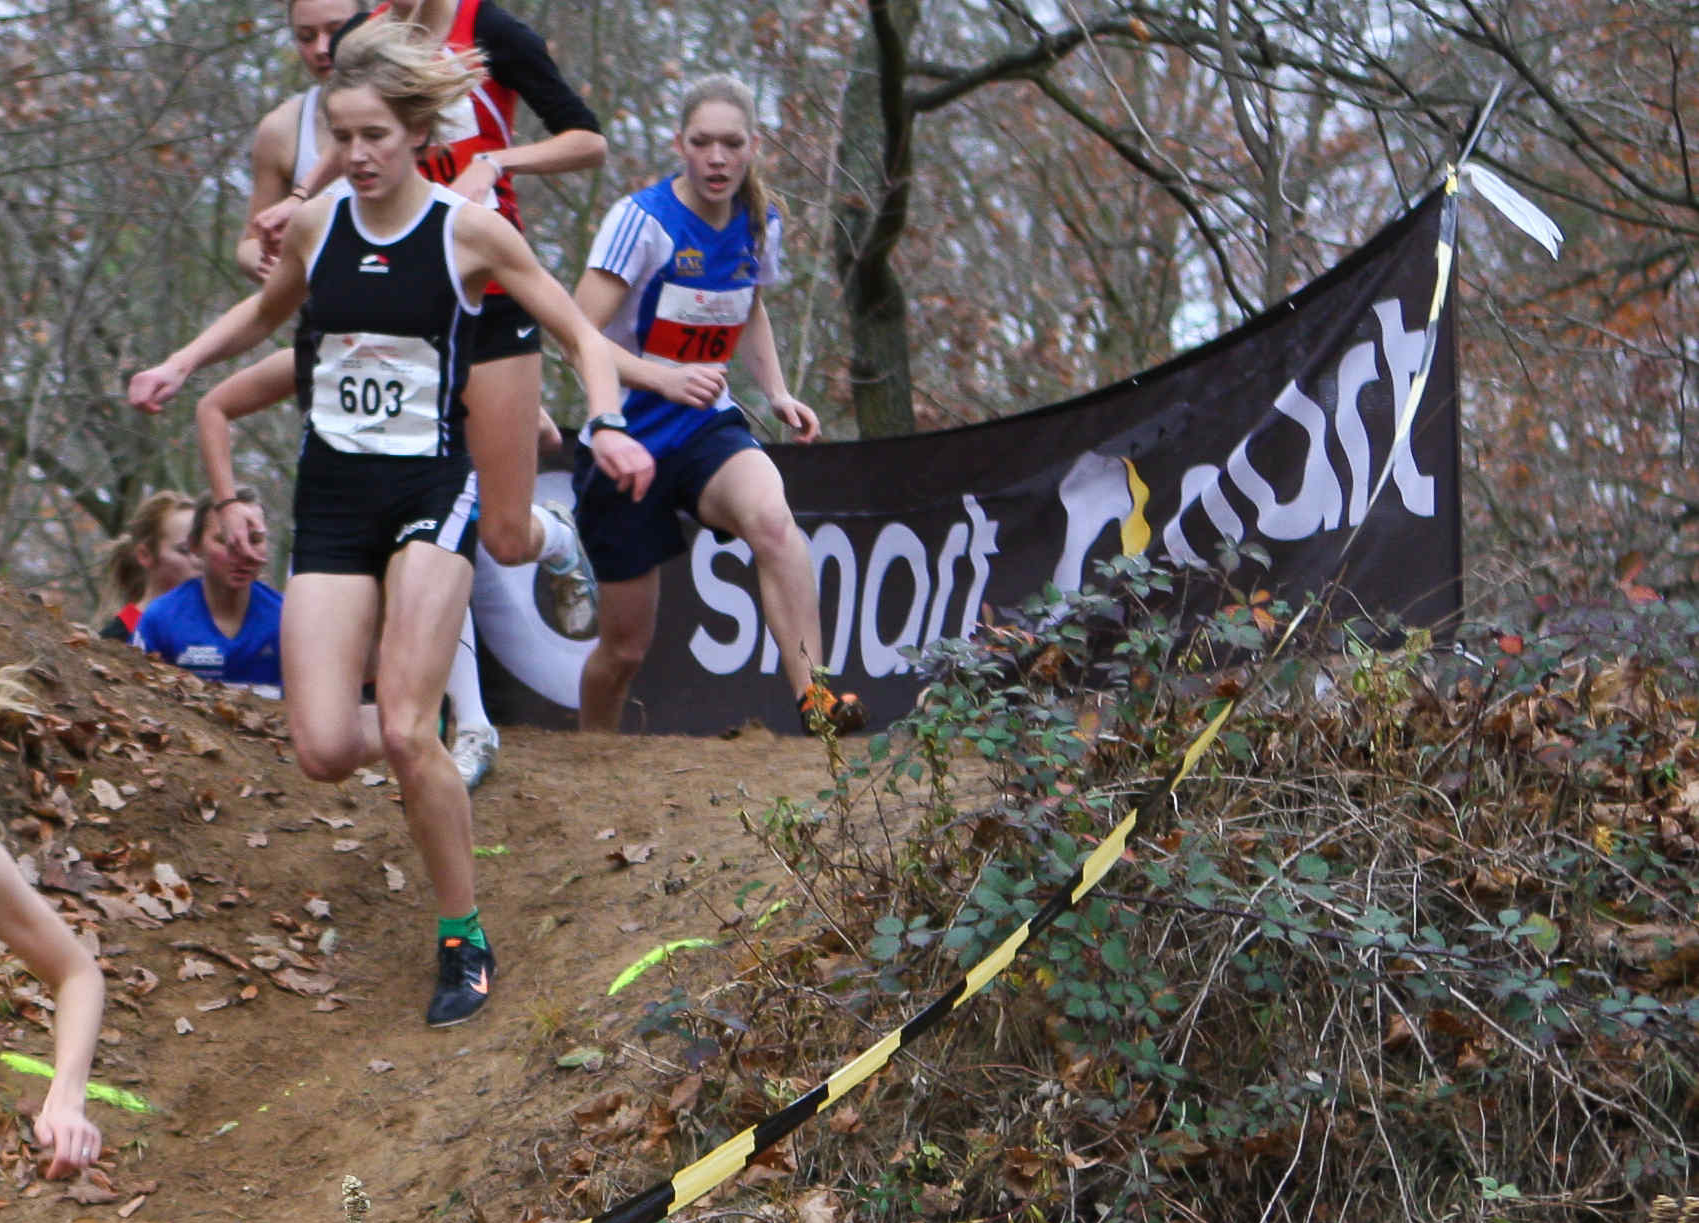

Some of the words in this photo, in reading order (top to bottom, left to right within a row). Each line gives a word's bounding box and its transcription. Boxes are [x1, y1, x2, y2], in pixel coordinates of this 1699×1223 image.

[677, 328, 729, 359] 716
[340, 376, 404, 417] 603
[689, 493, 1000, 680] smart
